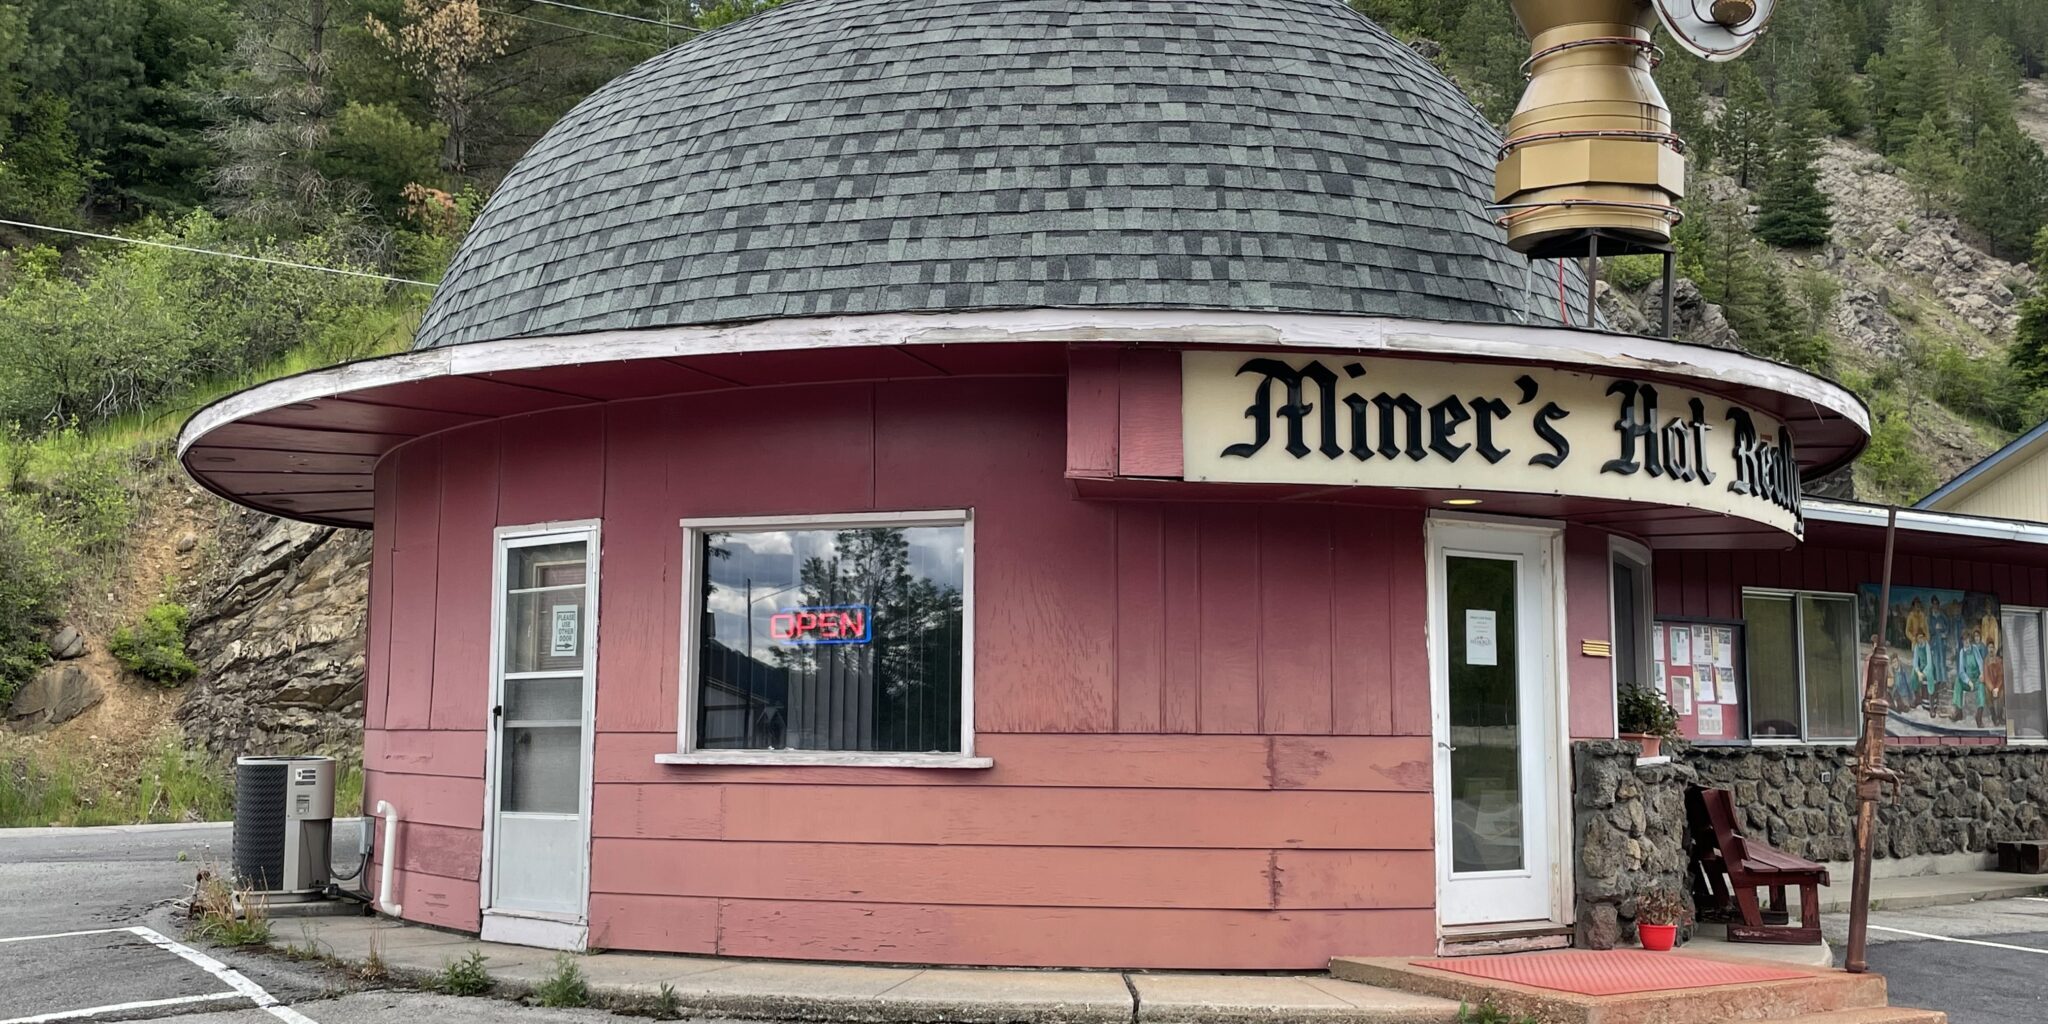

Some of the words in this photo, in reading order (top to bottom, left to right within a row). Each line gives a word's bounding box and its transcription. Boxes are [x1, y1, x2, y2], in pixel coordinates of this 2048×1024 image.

[1220, 358, 1570, 469] Miner's
[1600, 380, 1717, 486] Hat
[770, 611, 865, 639] OPEN
